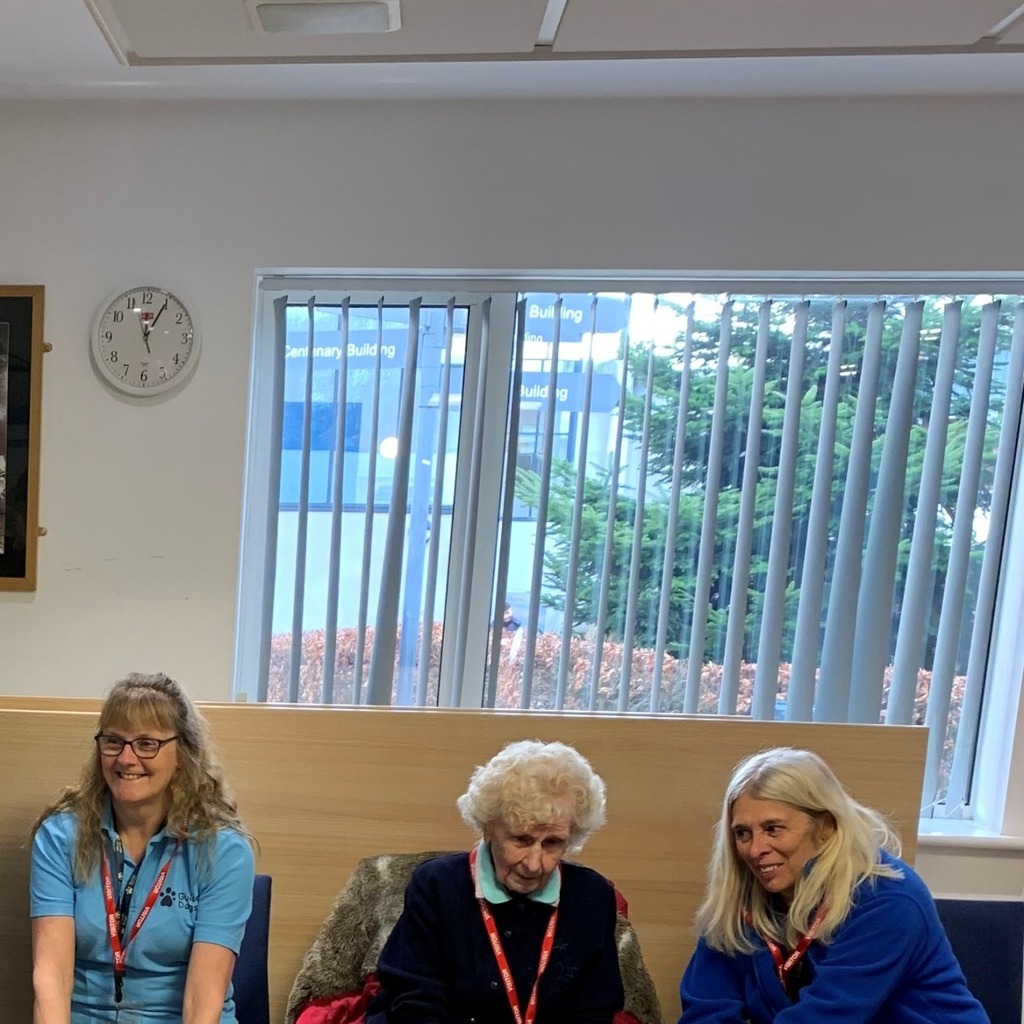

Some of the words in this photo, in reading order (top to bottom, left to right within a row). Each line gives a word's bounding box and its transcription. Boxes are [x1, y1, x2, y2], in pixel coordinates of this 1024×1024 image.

[127, 298, 135, 310] 11
[142, 293, 153, 304] 12
[113, 311, 124, 323] 10
[176, 313, 183, 324] 2
[105, 331, 112, 343] 9
[180, 333, 188, 344] 3
[110, 351, 118, 362] 8
[347, 343, 396, 358] Buildng
[172, 353, 180, 364] 4
[123, 364, 130, 376] 7
[140, 370, 147, 382] 6
[153, 872, 166, 894] VISITOR
[178, 901, 198, 913] Dogs
[136, 906, 150, 928] VISITOR
[490, 932, 502, 955] VISITOR
[538, 950, 549, 973] VISITOR
[783, 951, 800, 970] VISITOR
[502, 968, 513, 992] VISITOR
